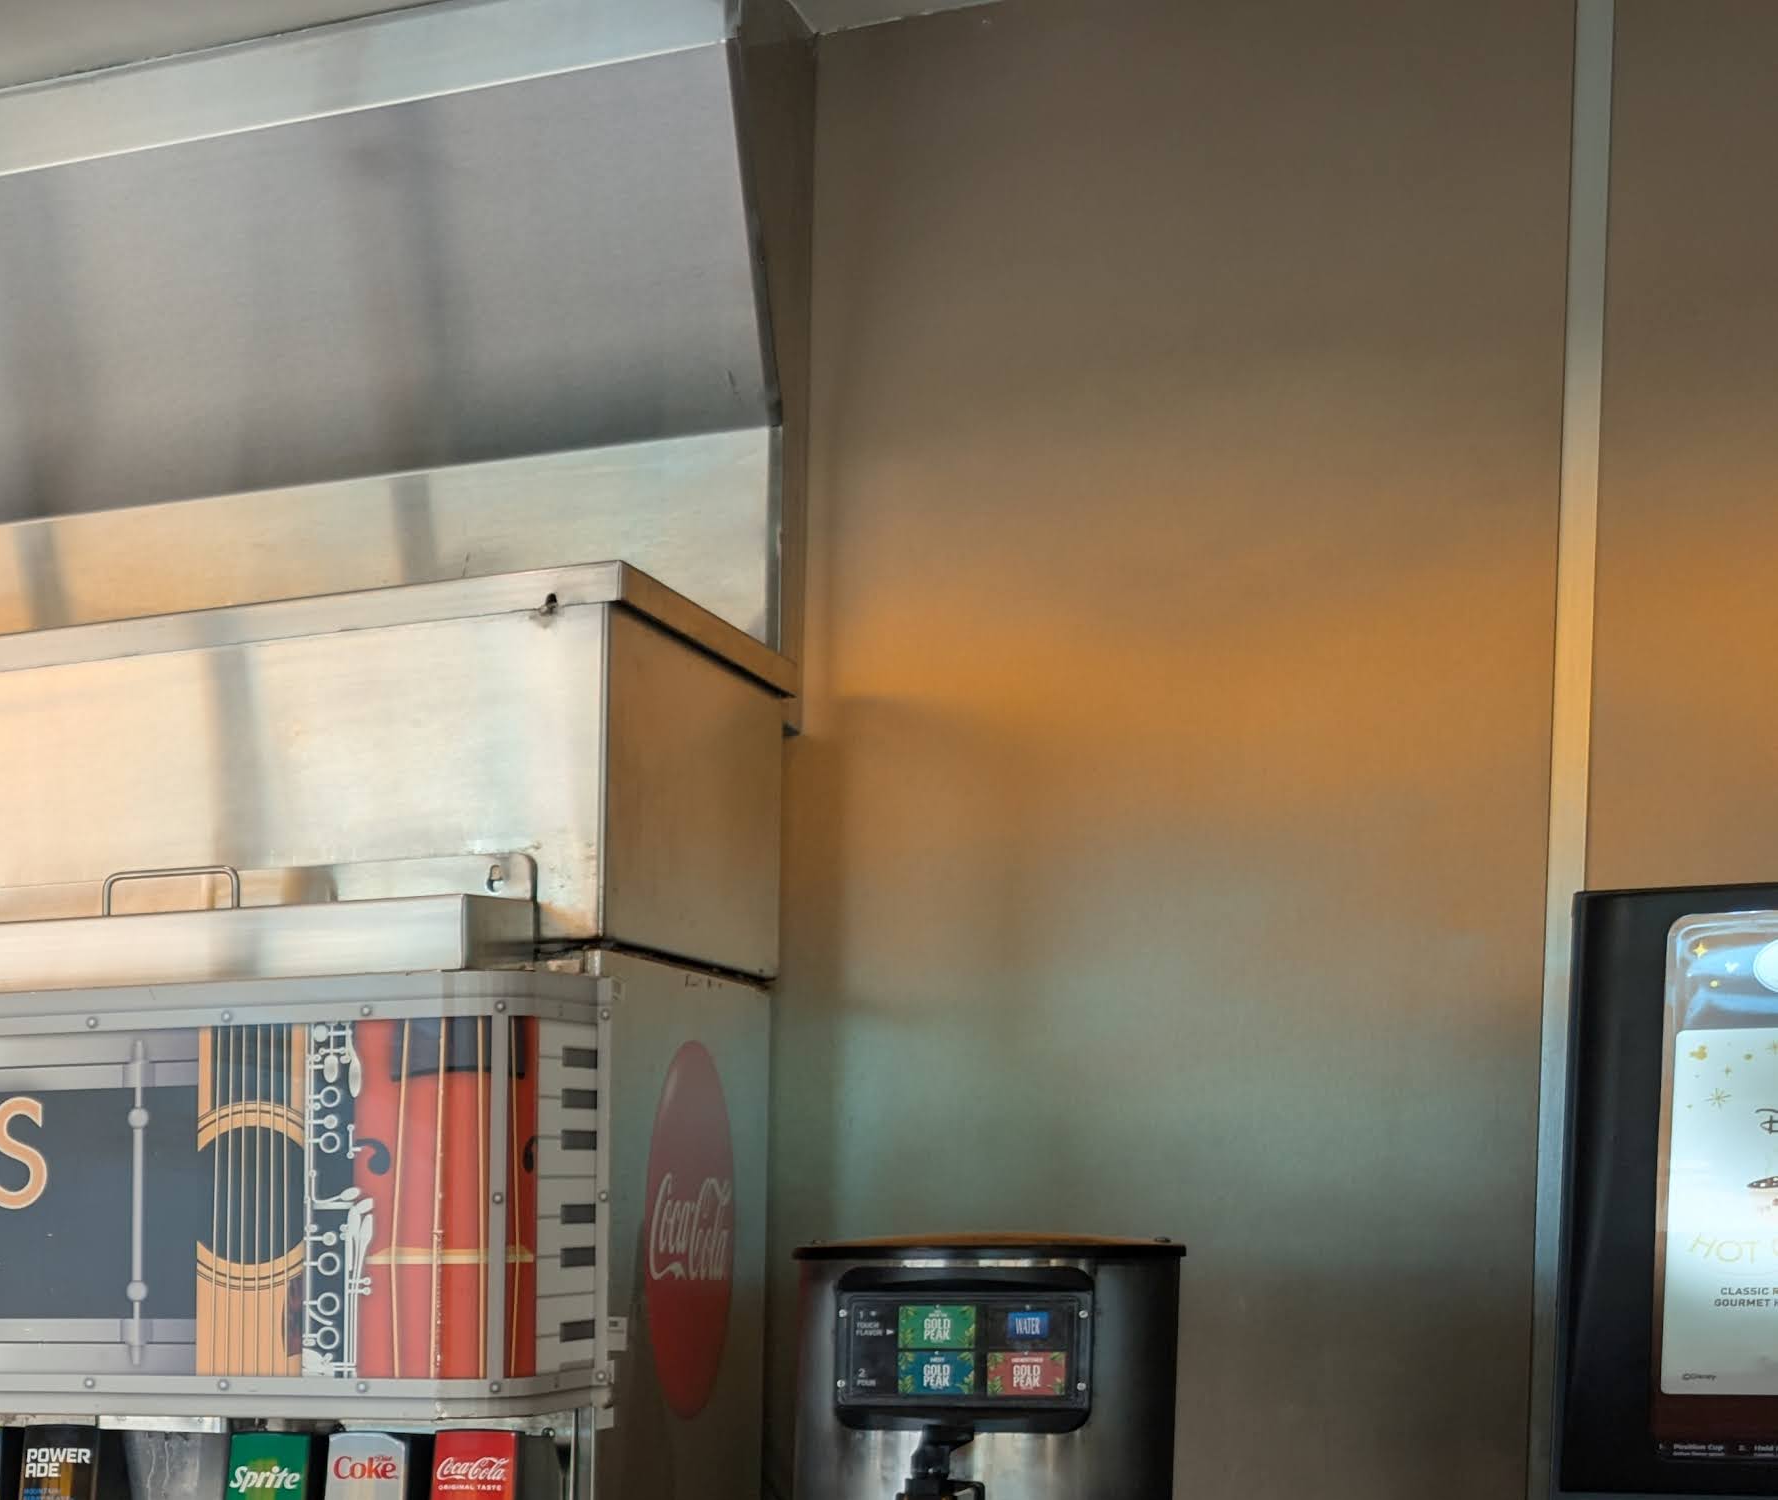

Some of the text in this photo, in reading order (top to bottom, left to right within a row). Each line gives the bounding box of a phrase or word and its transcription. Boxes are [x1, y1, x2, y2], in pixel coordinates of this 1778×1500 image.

[649, 1172, 733, 1281] Coca-Cola
[1720, 1287, 1770, 1296] CLASSIC
[1714, 1299, 1771, 1308] GOURMET
[924, 1318, 951, 1329] GOLD
[1015, 1317, 1041, 1335] WATER
[924, 1329, 950, 1341] PEAK
[923, 1364, 950, 1375] GOLD
[1013, 1364, 1041, 1376] GOLD
[923, 1375, 950, 1387] PEAK
[1013, 1375, 1041, 1387] PEAK
[26, 1448, 92, 1464] POWER
[24, 1462, 61, 1478] ADE
[333, 1455, 397, 1480] Coke
[436, 1456, 510, 1481] Coca-Cola
[229, 1465, 301, 1493] Sprite
